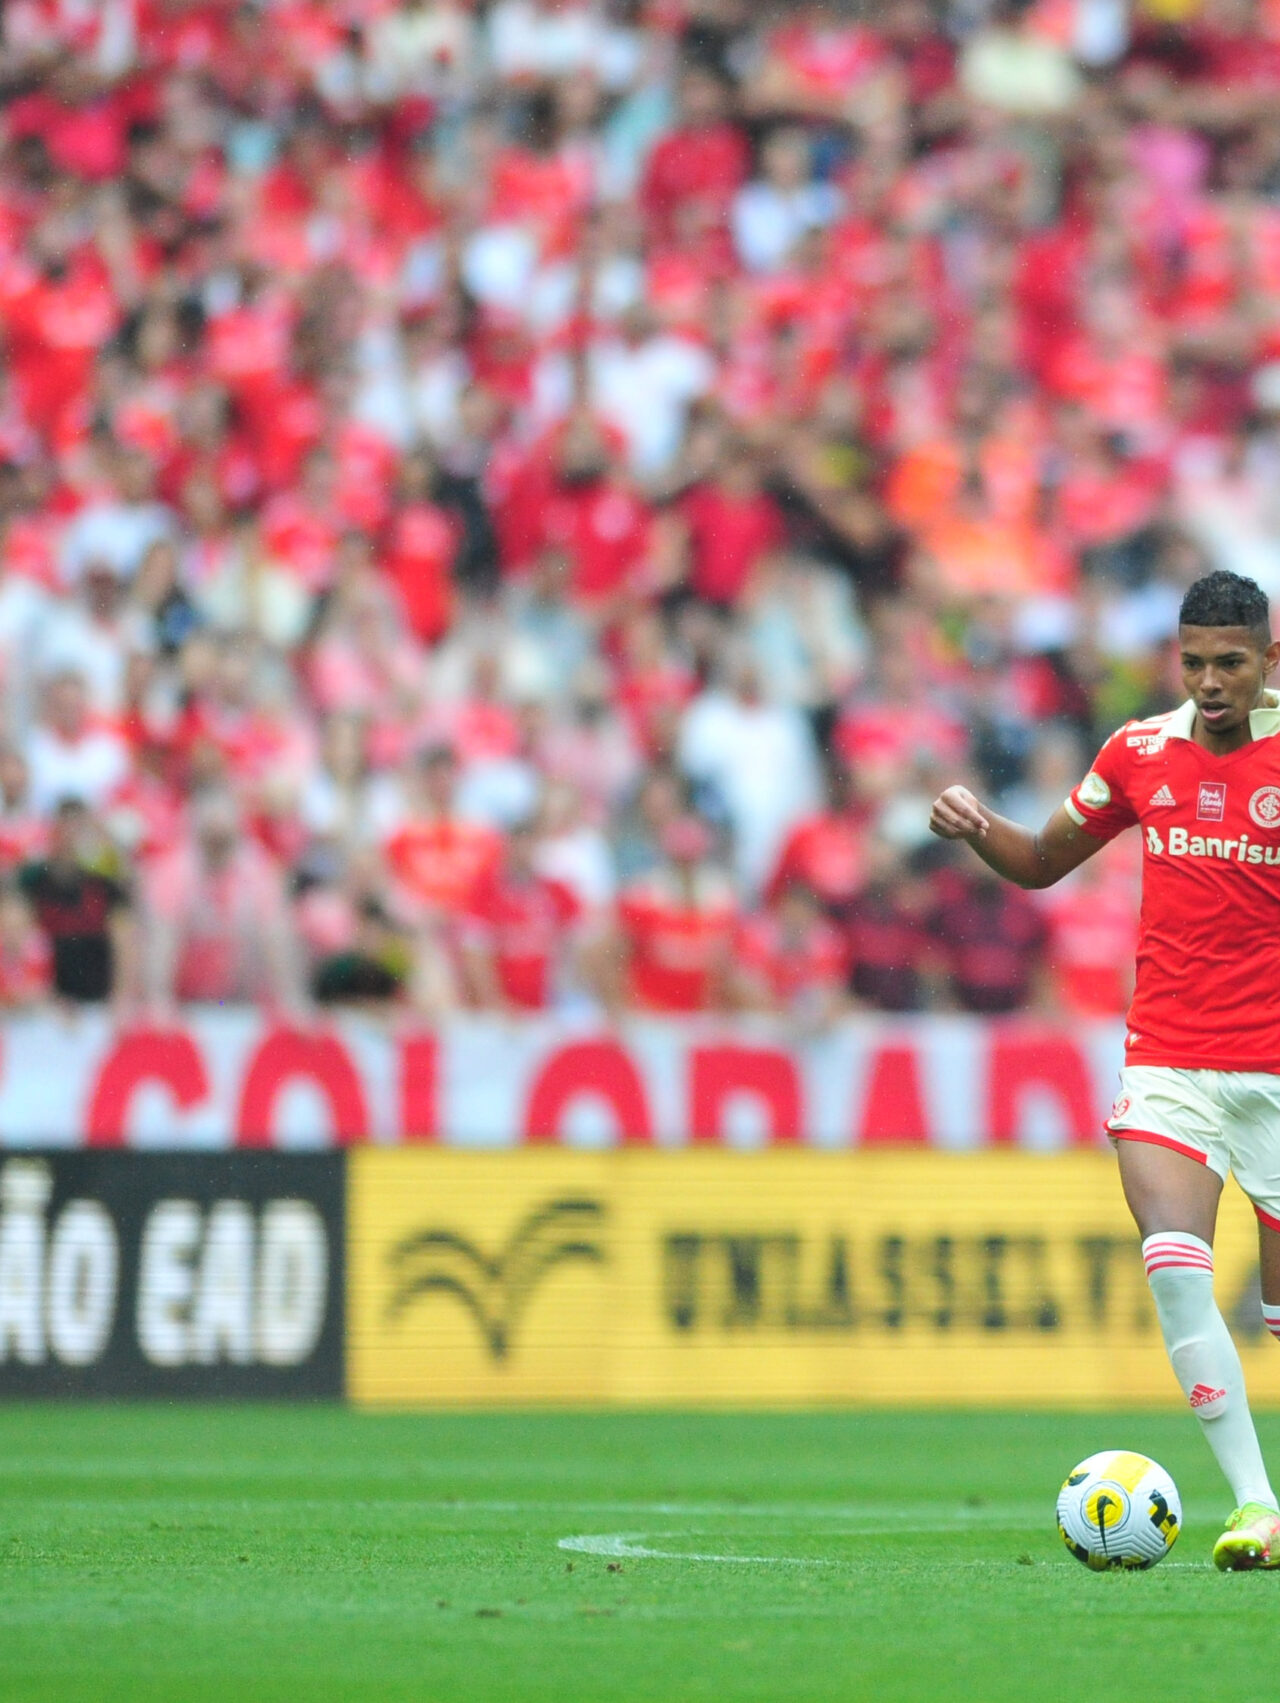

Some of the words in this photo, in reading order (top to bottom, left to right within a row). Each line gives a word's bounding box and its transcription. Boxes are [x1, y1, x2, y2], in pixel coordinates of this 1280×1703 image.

[1126, 735, 1168, 748] ESTRE
[84, 1024, 1110, 1147] COLORAD
[136, 1197, 328, 1367] EAD
